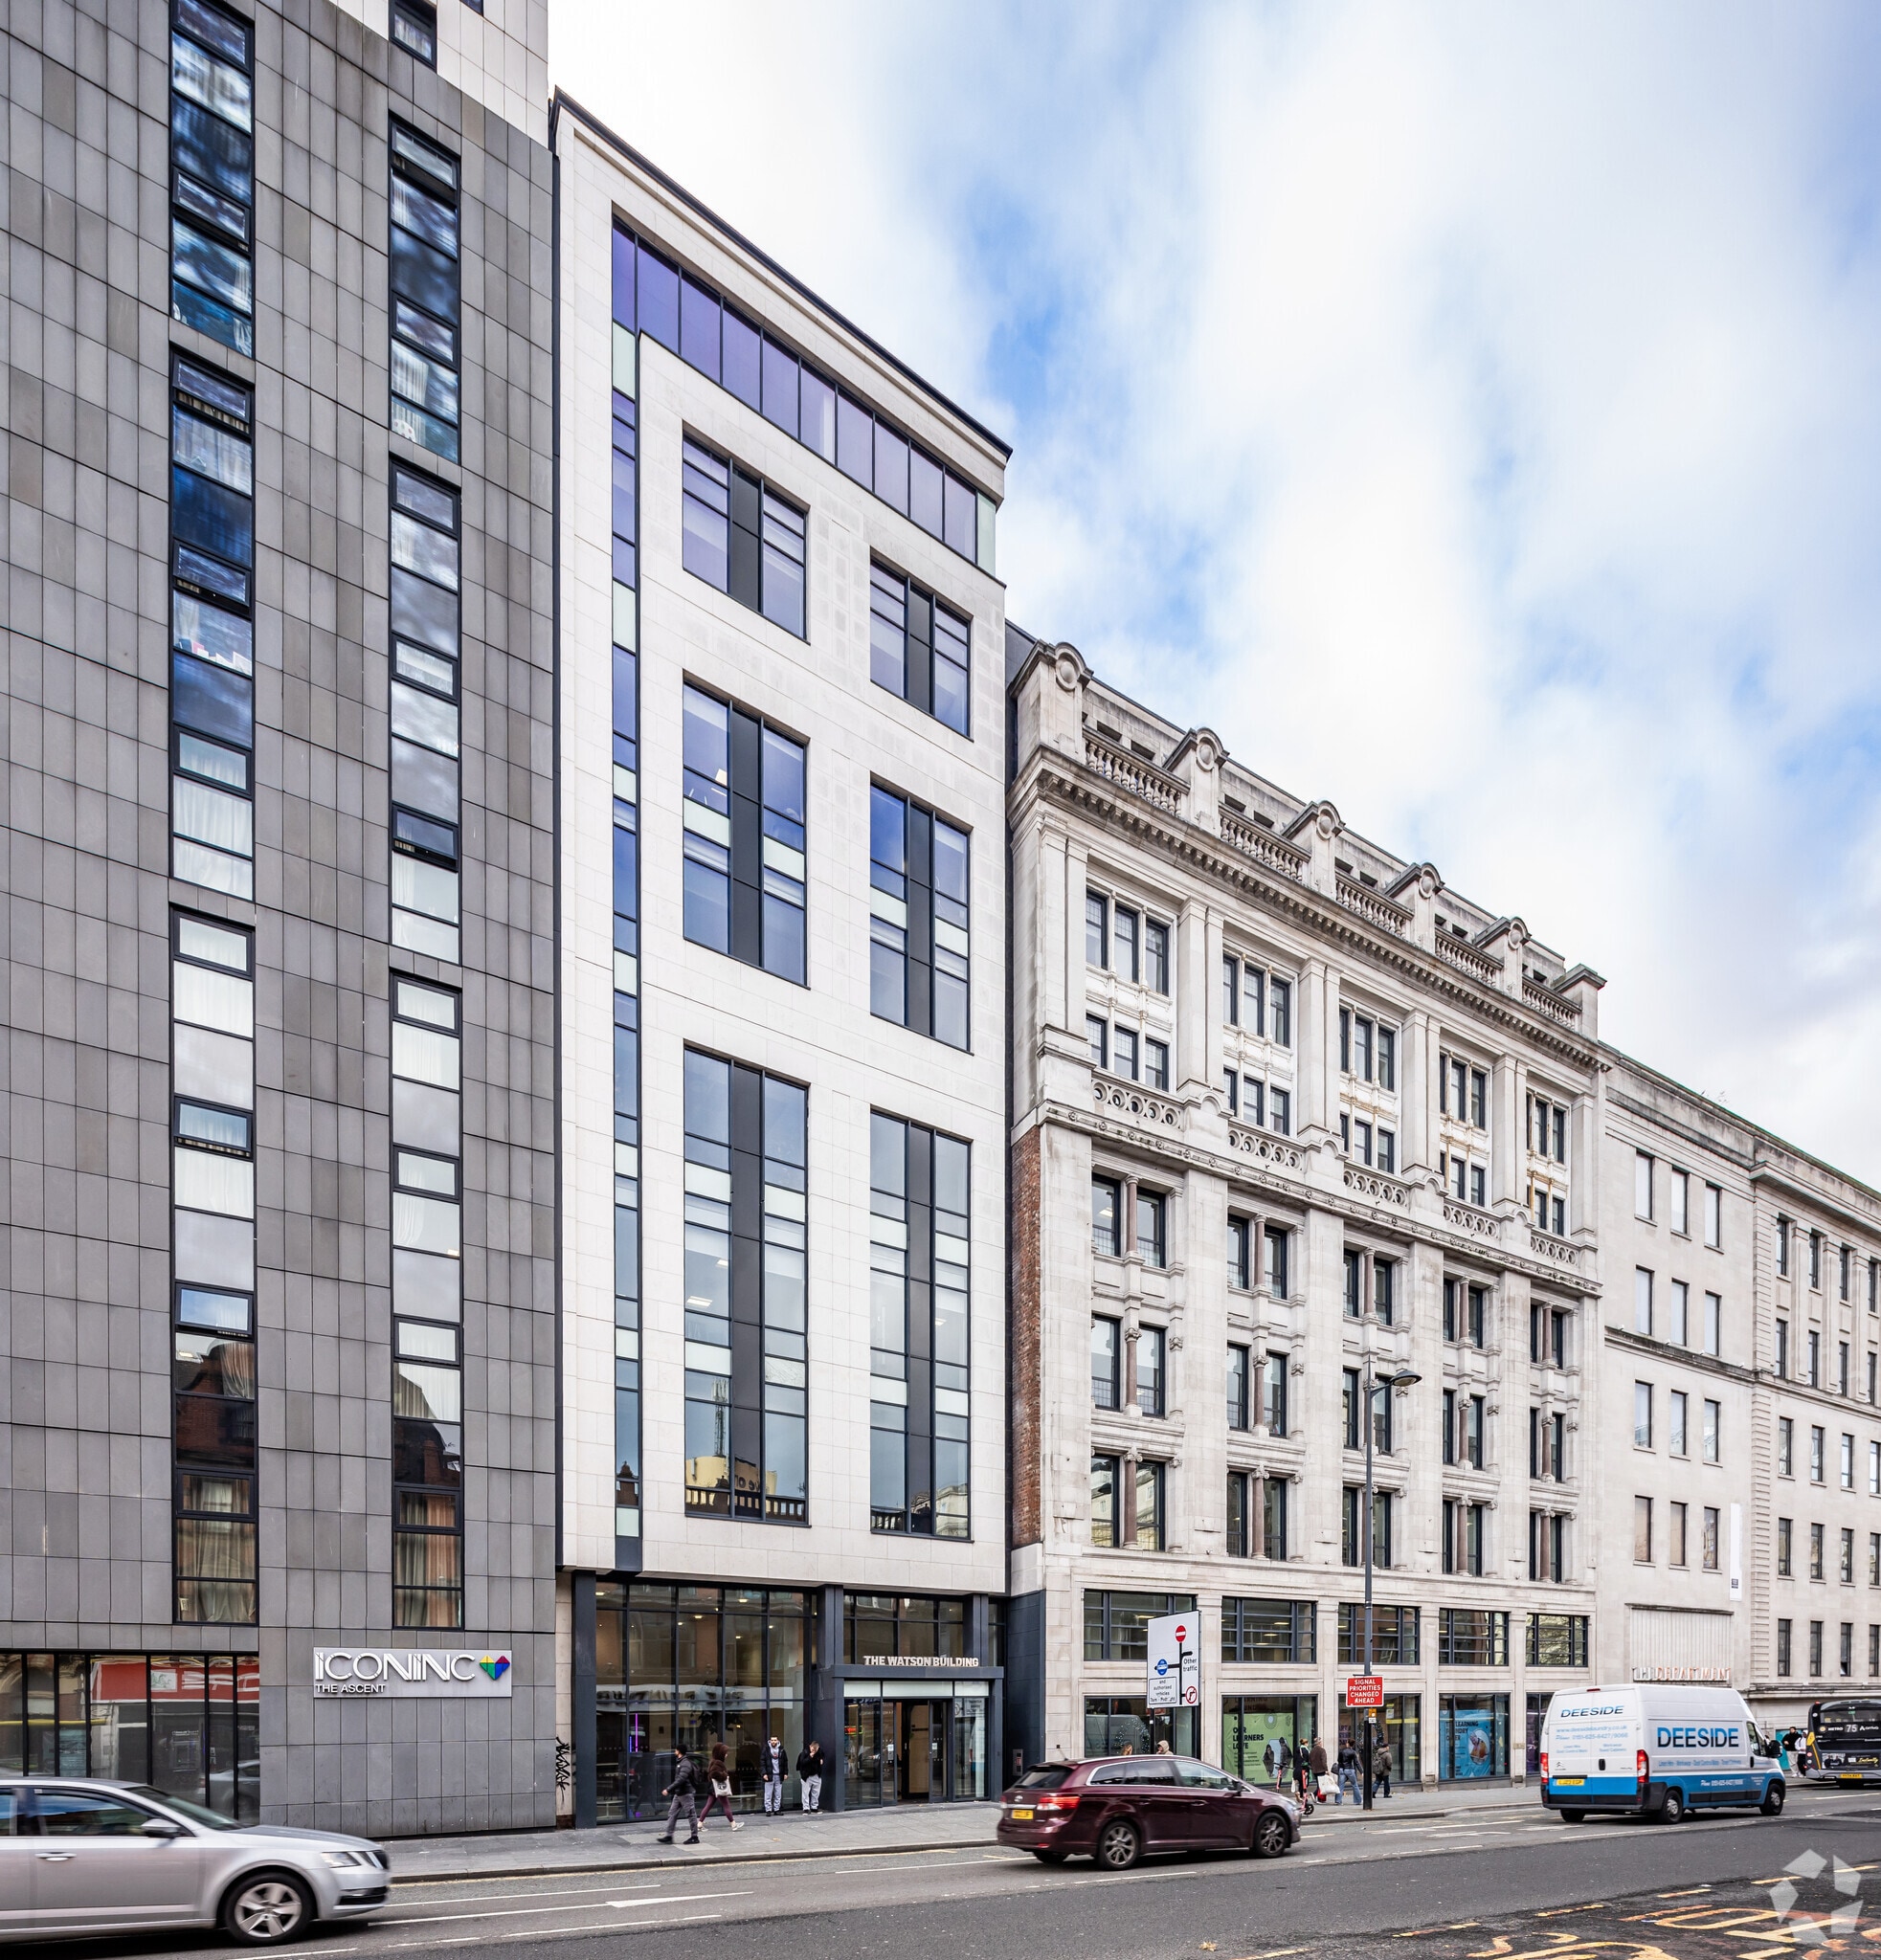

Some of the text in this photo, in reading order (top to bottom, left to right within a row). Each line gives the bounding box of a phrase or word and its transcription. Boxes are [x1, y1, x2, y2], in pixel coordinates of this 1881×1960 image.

[863, 1656, 979, 1667] THE WATSON BUILDING
[1656, 1667, 1731, 1682] DEPARTMENT
[315, 1683, 387, 1693] THE ASCENT
[1560, 1705, 1624, 1718] DEESIDE
[1846, 1724, 1857, 1732] 75
[1657, 1727, 1739, 1748] DEESIDE
